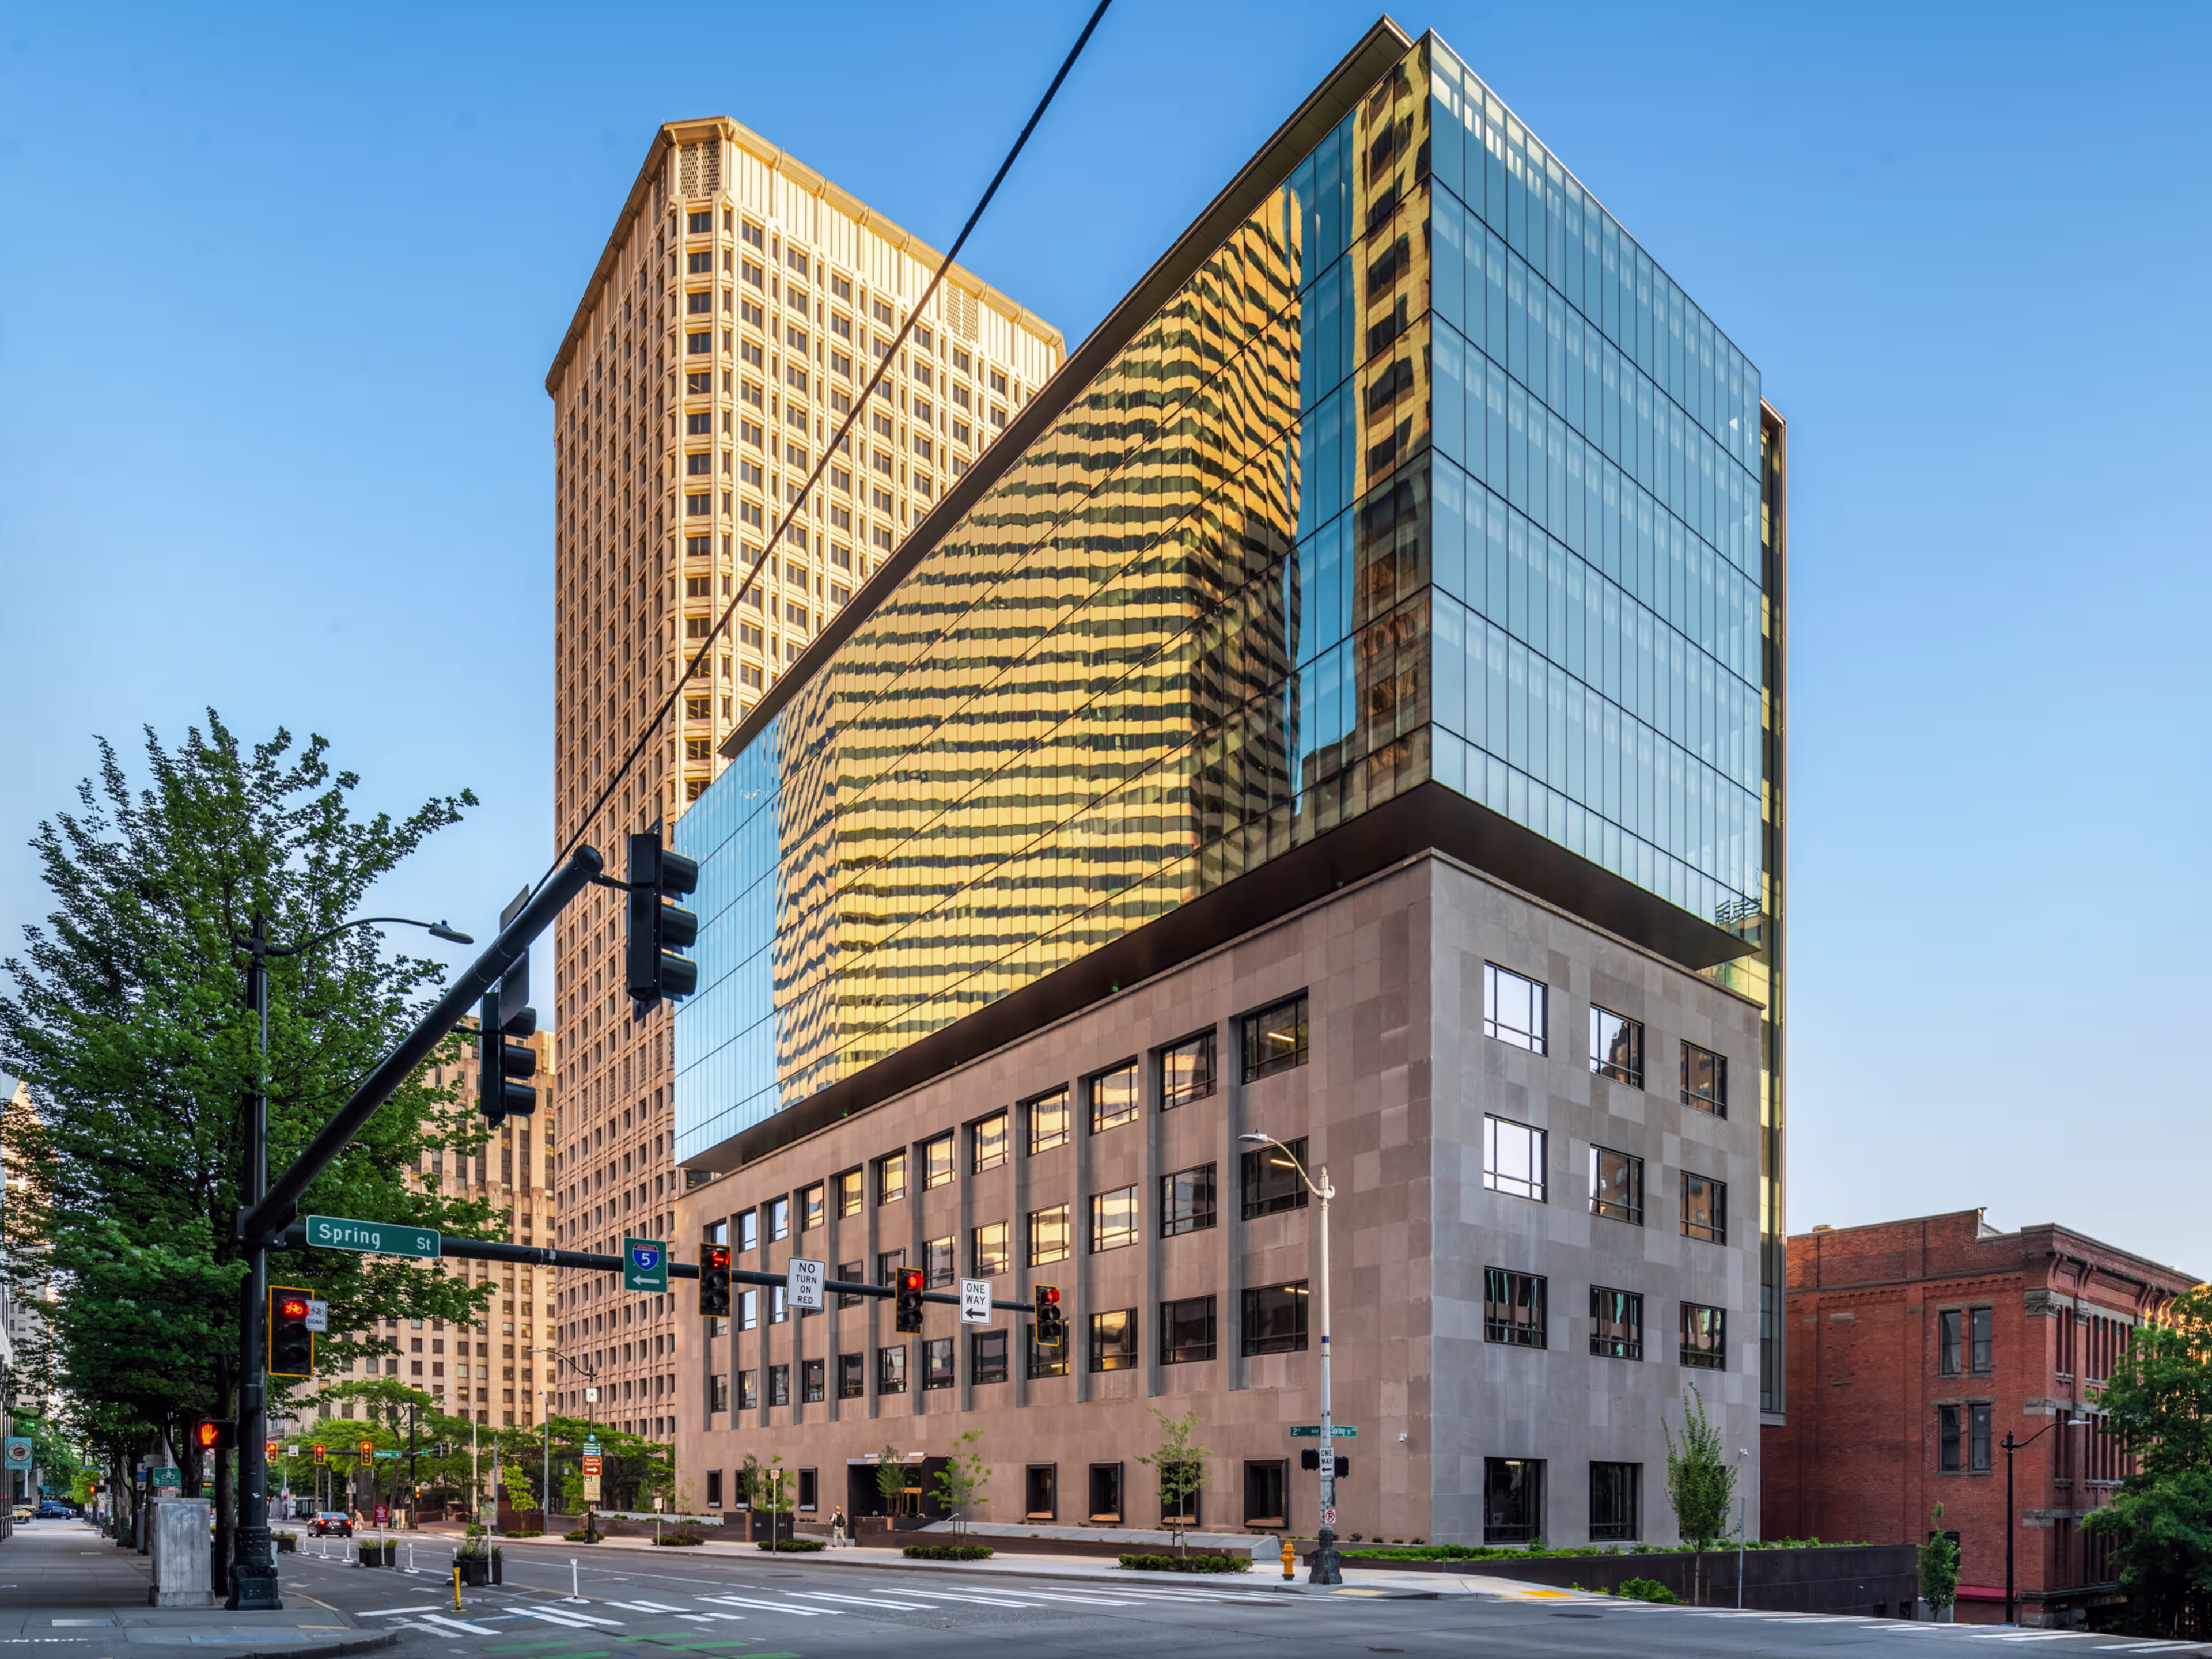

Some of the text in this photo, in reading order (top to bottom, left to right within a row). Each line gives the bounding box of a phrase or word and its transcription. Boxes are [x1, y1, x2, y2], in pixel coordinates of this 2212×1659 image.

[319, 1223, 431, 1251] Spring St
[642, 1252, 650, 1266] 5
[798, 1262, 816, 1274] NO
[796, 1274, 817, 1284] TURN
[800, 1285, 812, 1294] ON
[967, 1283, 985, 1294] ONE
[797, 1295, 813, 1304] RED
[965, 1294, 986, 1305] WAY
[1331, 1426, 1346, 1437] Spring
